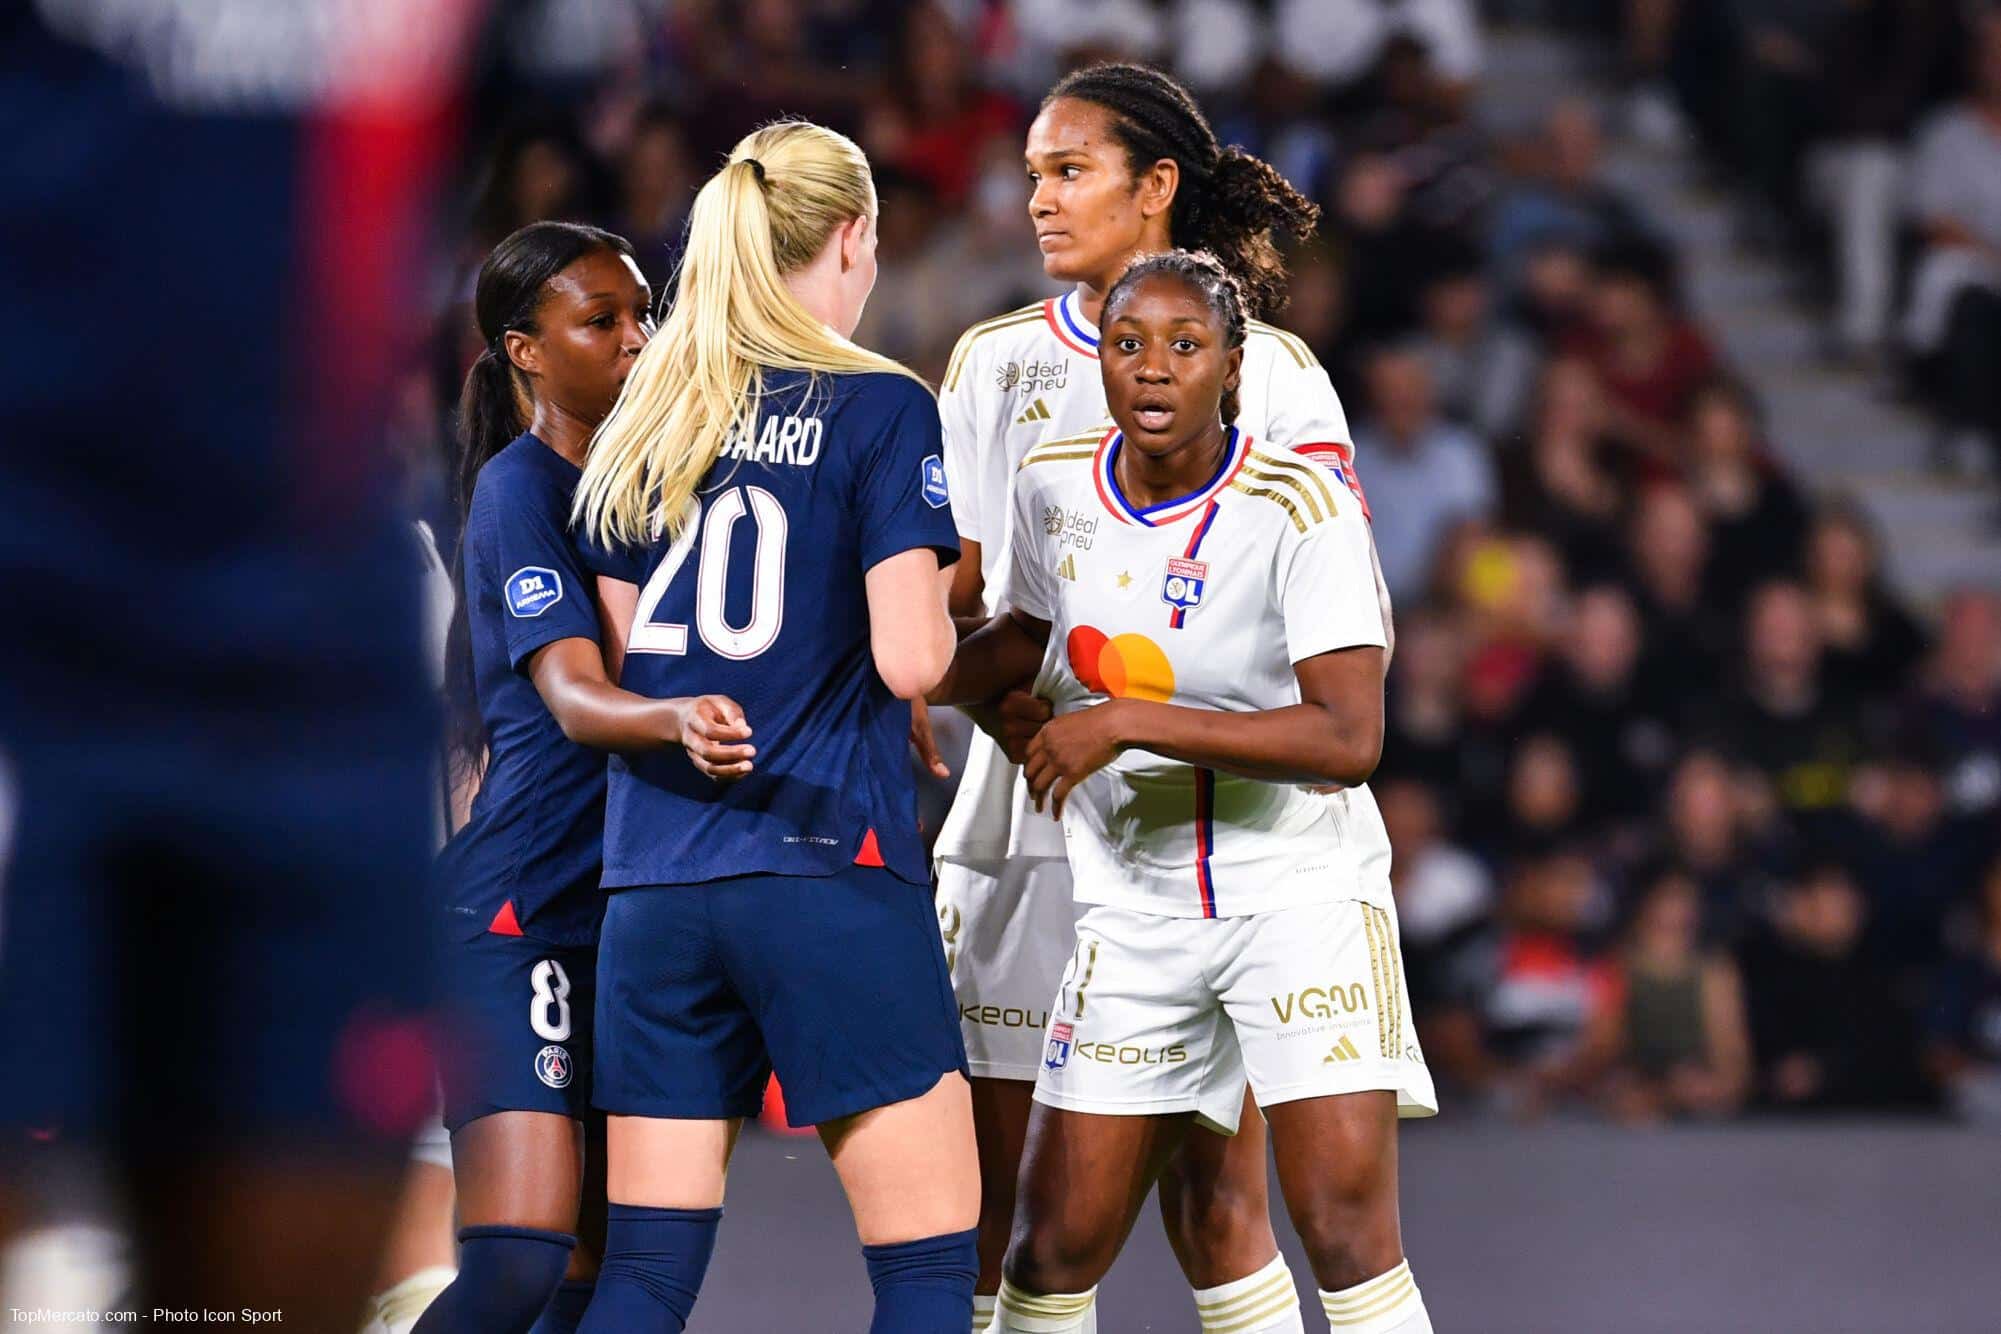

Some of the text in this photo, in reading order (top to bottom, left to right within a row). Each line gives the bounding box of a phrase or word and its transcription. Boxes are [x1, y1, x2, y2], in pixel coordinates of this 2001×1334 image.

[1021, 358, 1069, 378] Idéal
[1021, 377, 1067, 398] pneu
[1063, 508, 1099, 535] Idéal
[1059, 530, 1093, 551] pneu
[518, 576, 544, 595] D1
[626, 485, 788, 661] 20
[1166, 577, 1200, 603] OL
[530, 959, 571, 1042] 8
[958, 1003, 1050, 1028] KeOLI
